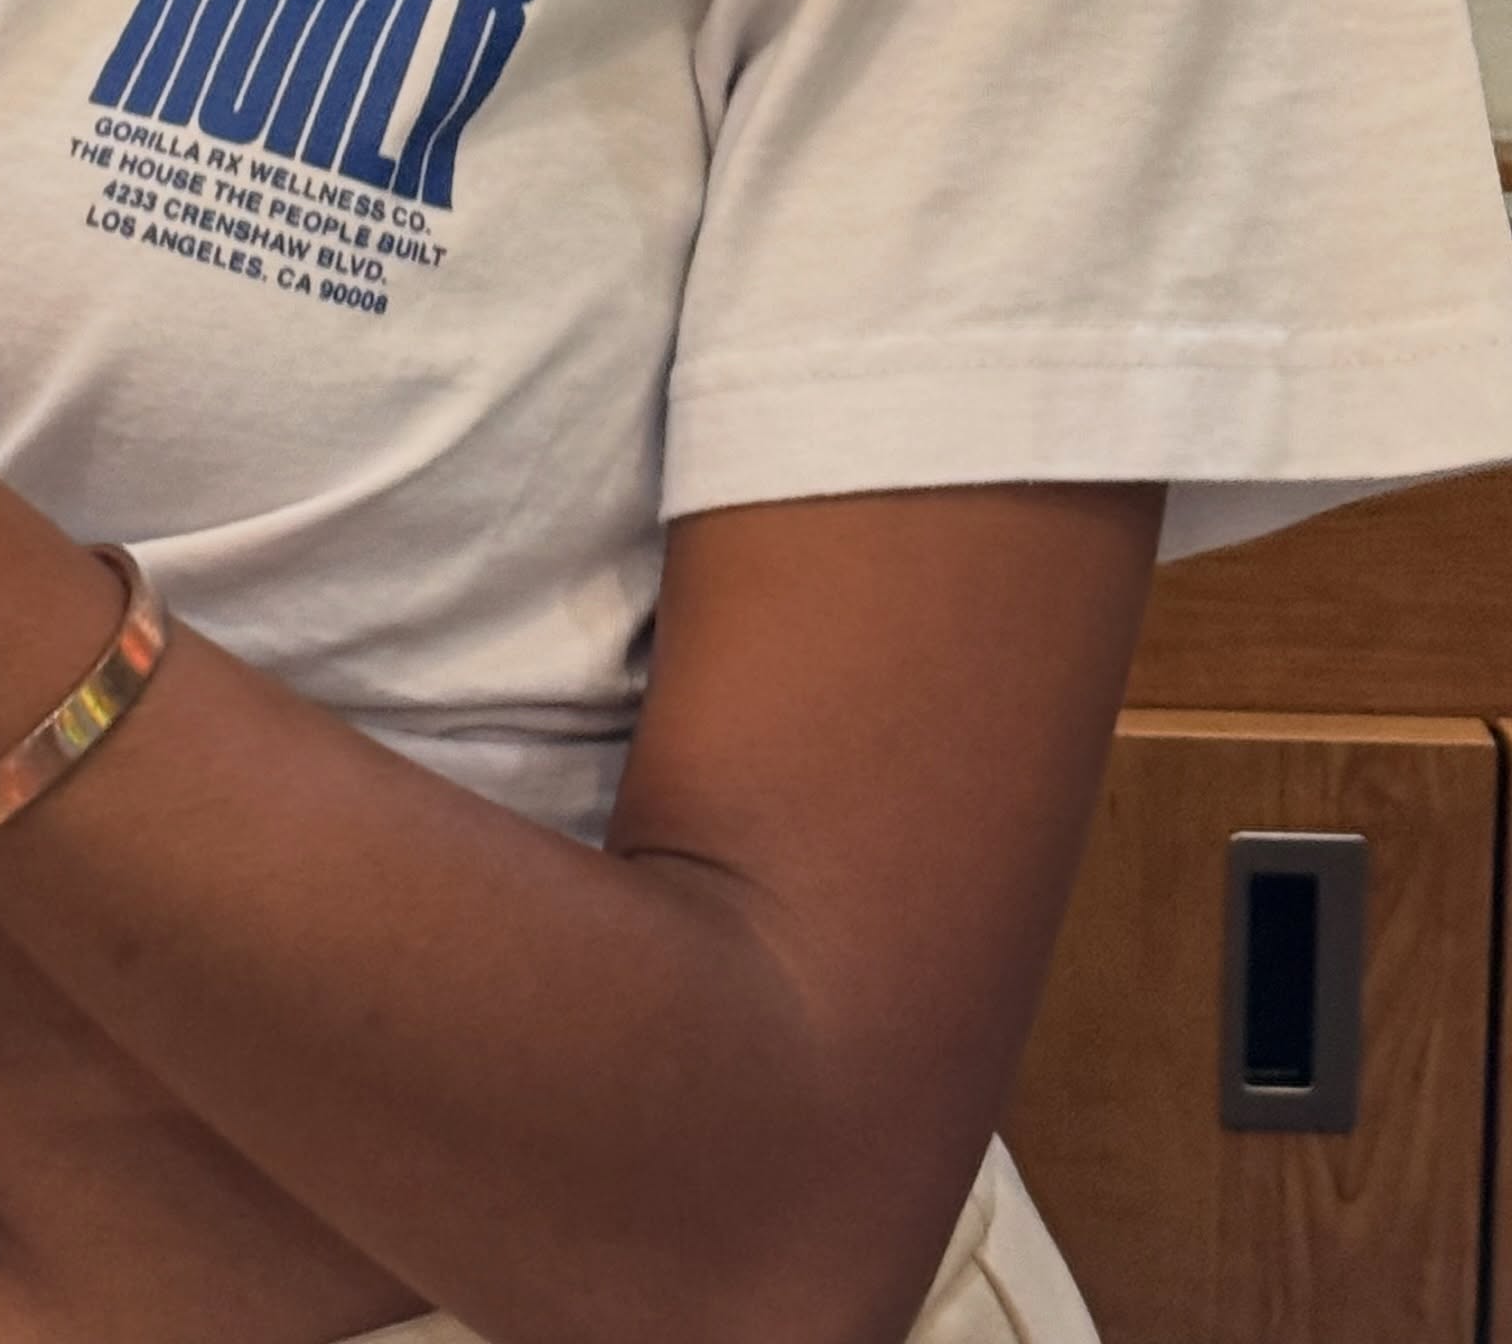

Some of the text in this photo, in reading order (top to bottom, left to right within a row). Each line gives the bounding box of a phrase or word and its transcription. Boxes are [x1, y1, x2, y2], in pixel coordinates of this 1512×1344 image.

[70, 136, 448, 267] THE HOUSE THE PEOPLE BUILT
[94, 116, 432, 236] GORILLA RX WELLNESS CO.
[102, 179, 388, 286] 4233 CRENSHAW BLVD.
[85, 203, 137, 239] LOS
[276, 266, 313, 296] CA
[319, 278, 389, 315] 90008
